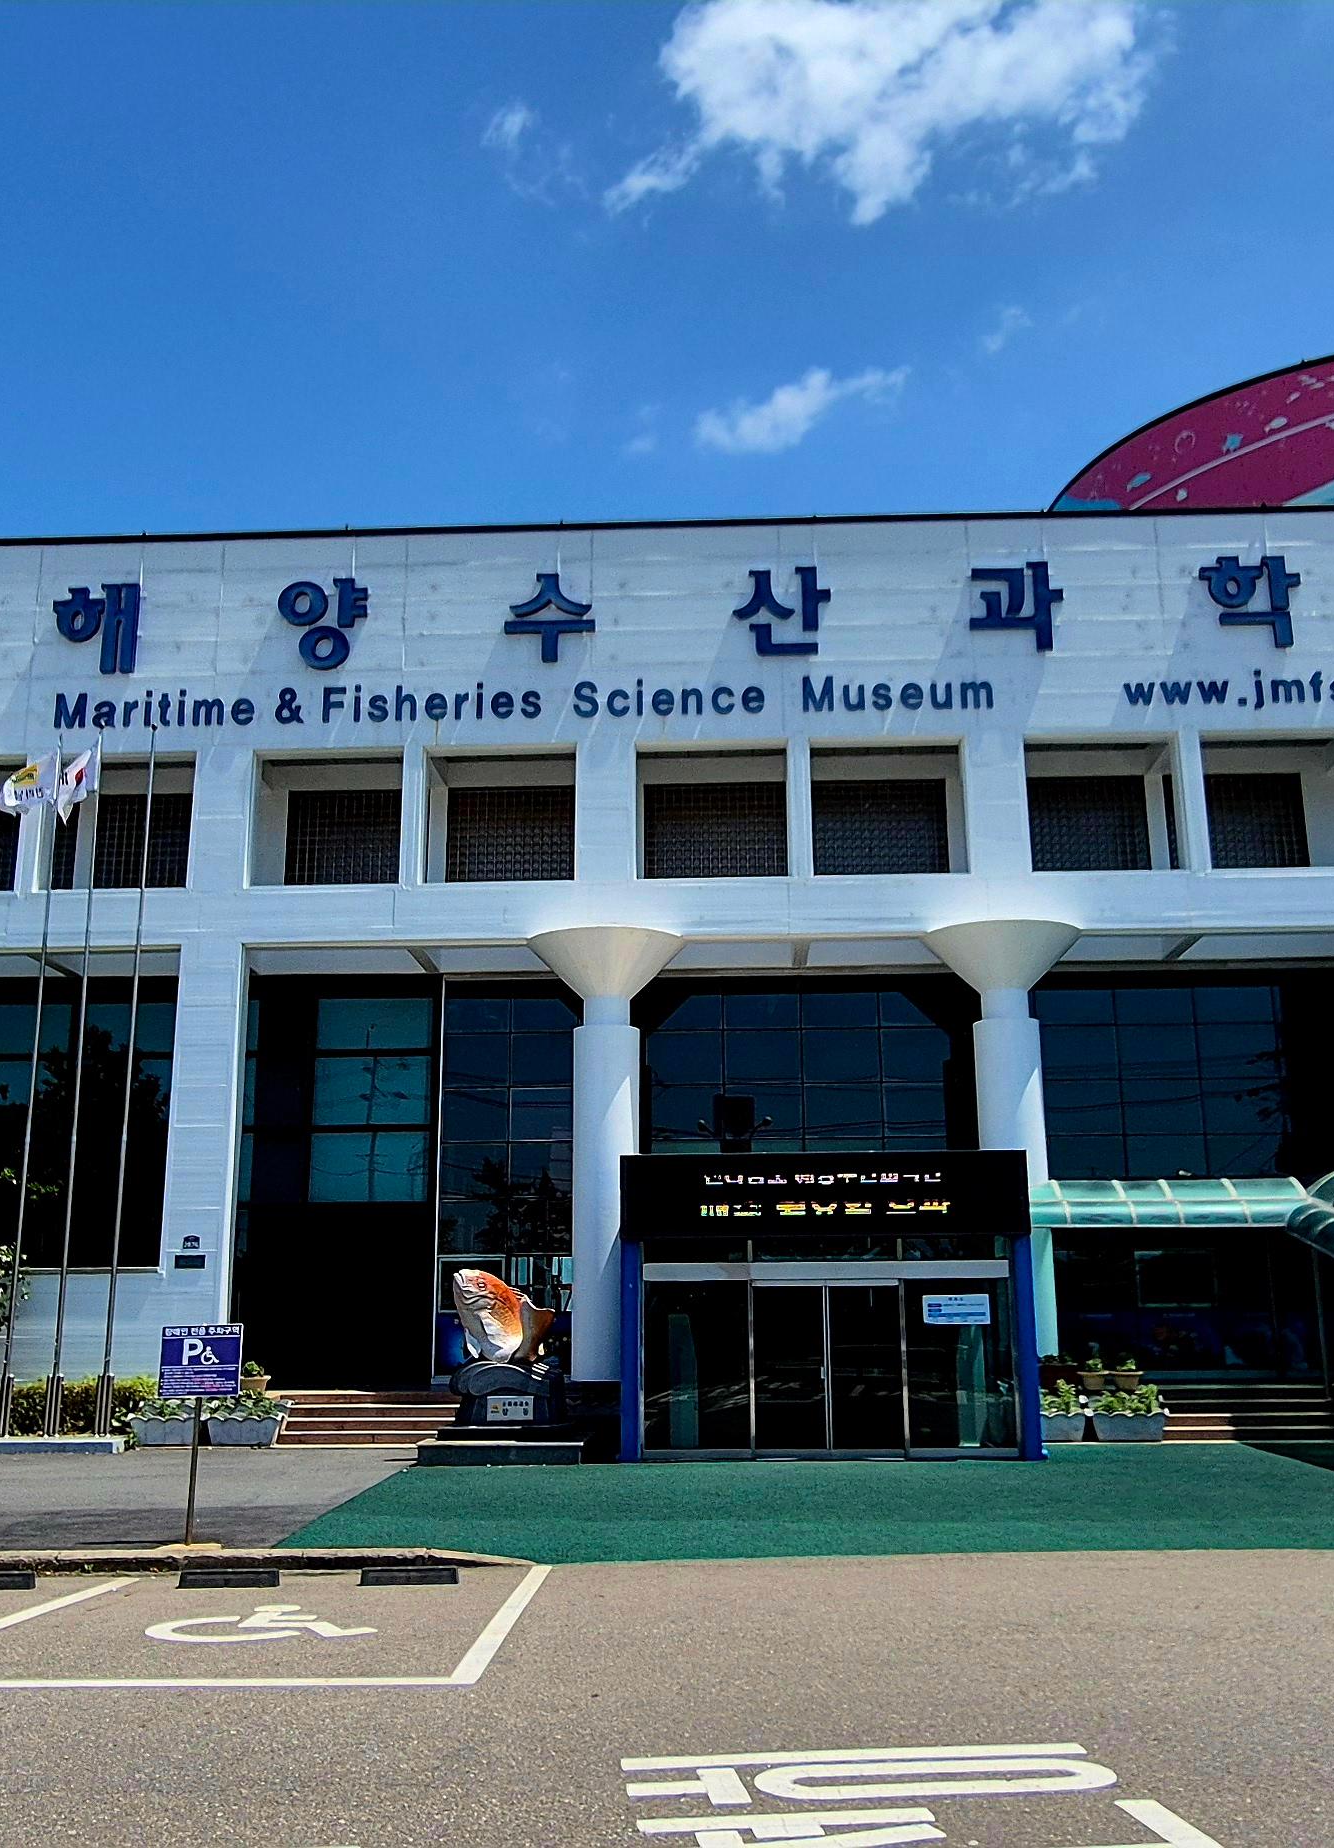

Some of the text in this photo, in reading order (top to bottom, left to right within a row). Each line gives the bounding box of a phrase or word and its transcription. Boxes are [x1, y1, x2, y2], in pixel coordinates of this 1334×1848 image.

[54, 675, 994, 729] Maritime & Fisheries Science Museum
[182, 1338, 204, 1366] P
